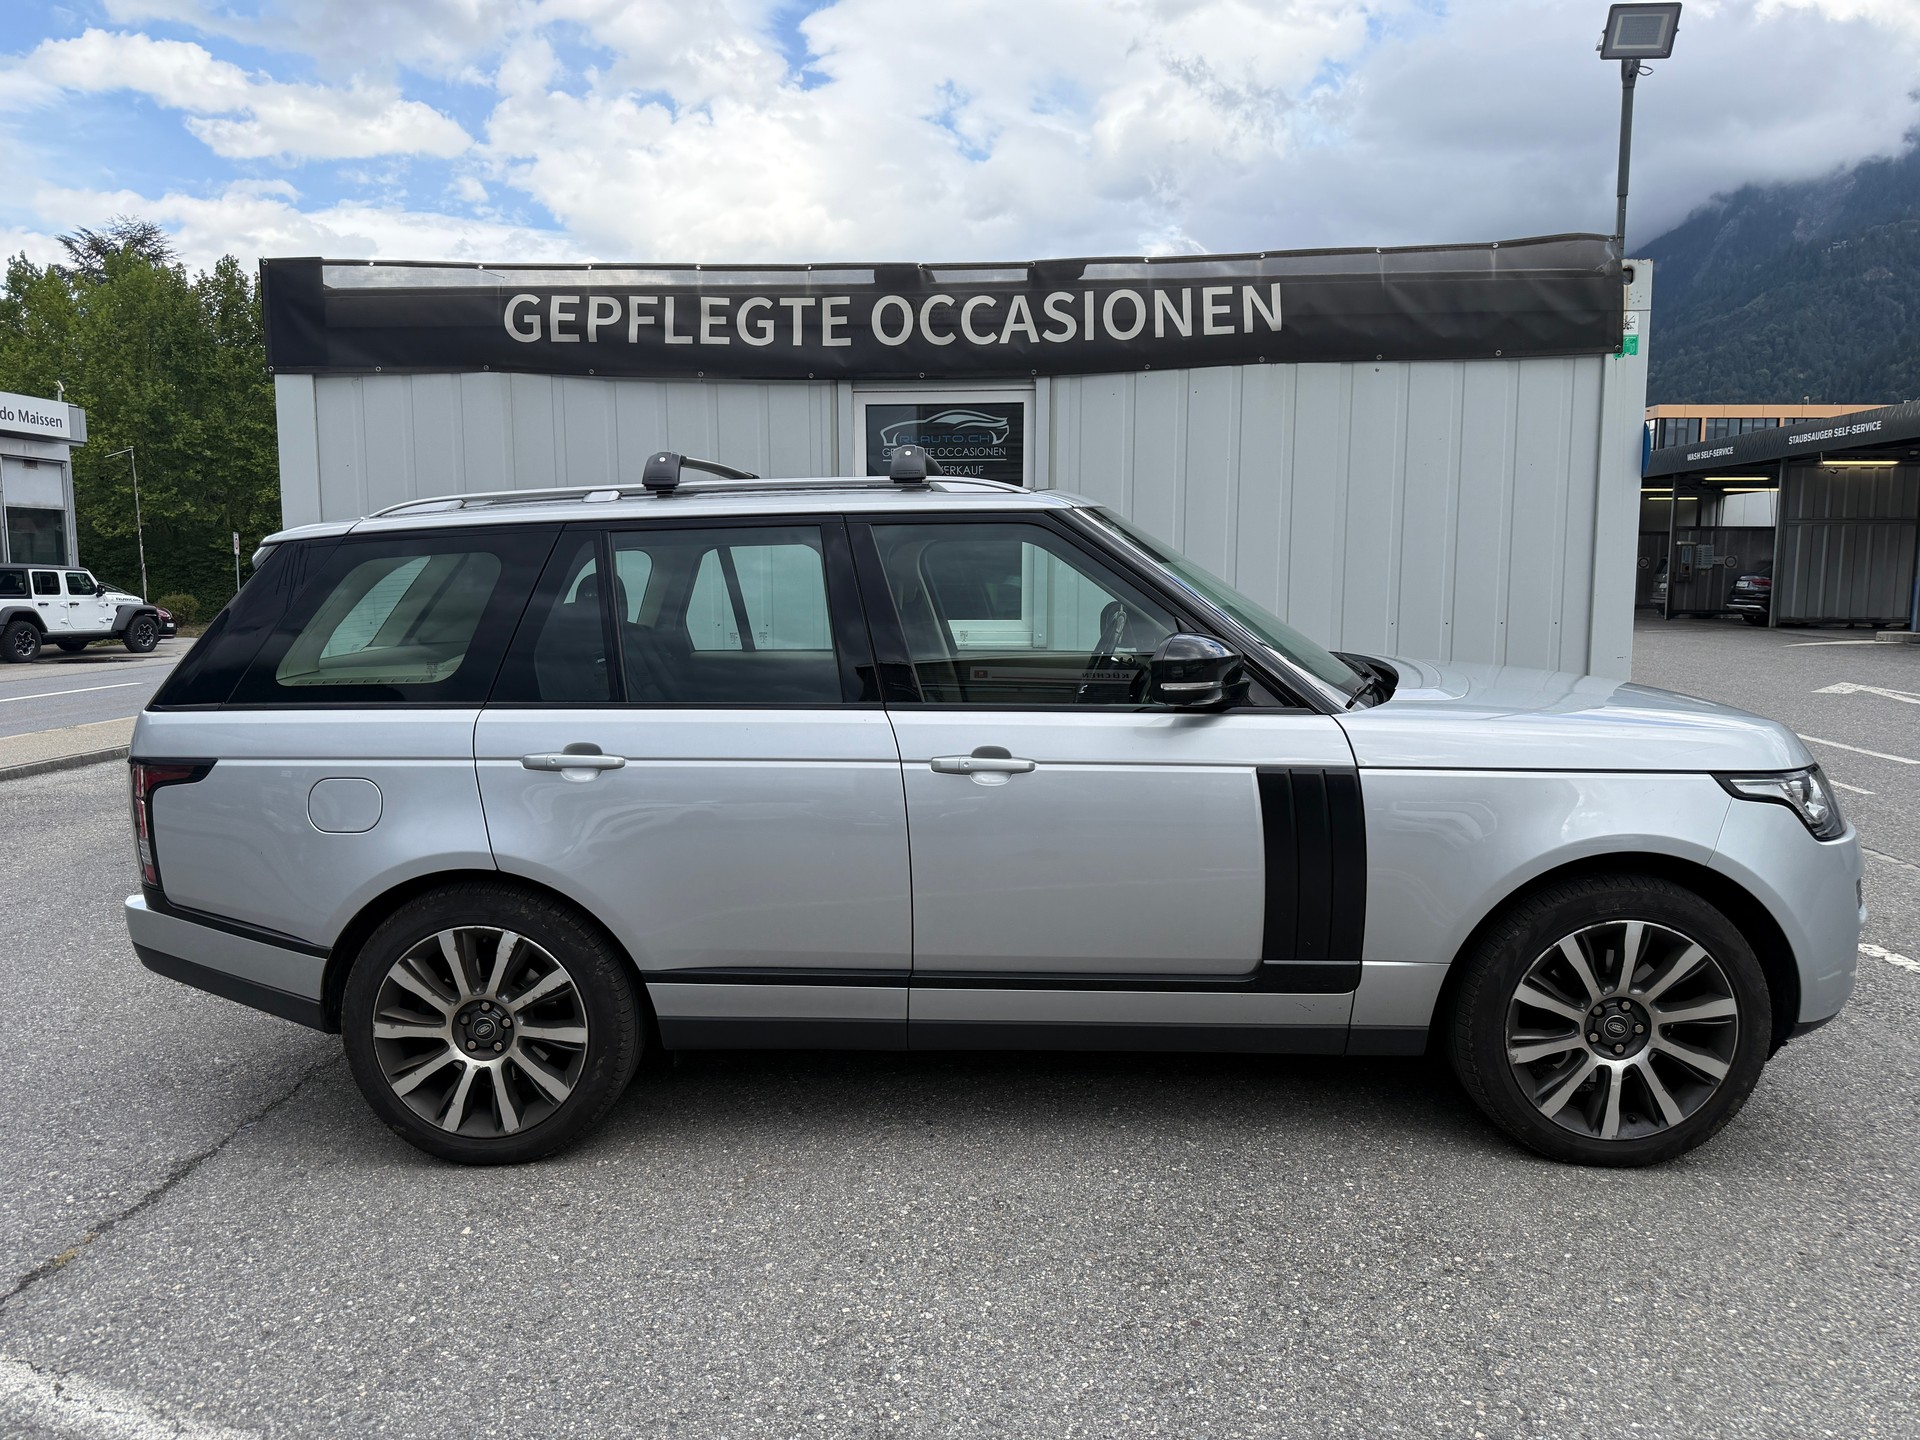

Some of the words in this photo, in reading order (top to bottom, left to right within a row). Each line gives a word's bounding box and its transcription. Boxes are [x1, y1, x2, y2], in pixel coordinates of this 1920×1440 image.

[503, 293, 852, 347] GEPFLEGTE
[871, 285, 1282, 346] OCCASIONEN
[18, 409, 63, 428] Maissen
[1788, 429, 1833, 445] STAUBSAUGER
[1833, 420, 1882, 437] SELF-SERVICE
[937, 447, 1006, 457] OCCASIONEN
[1700, 446, 1734, 459] SELF-SERVICE
